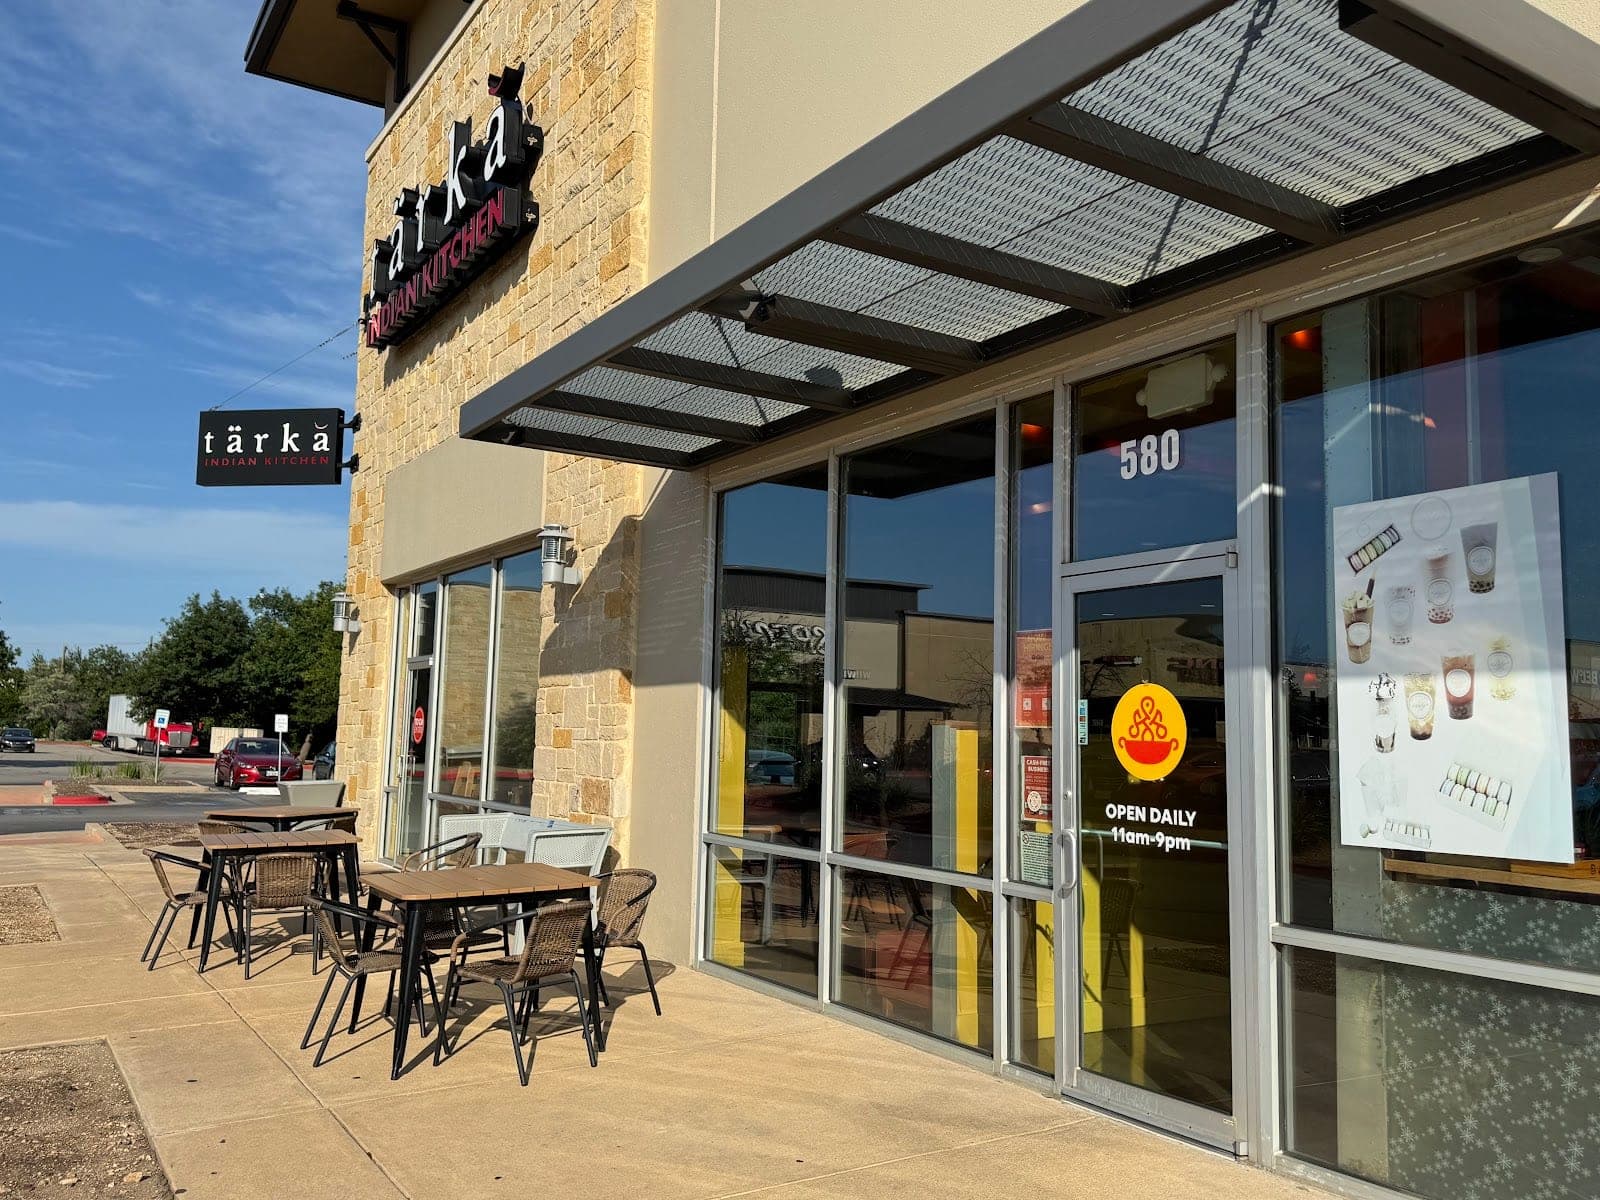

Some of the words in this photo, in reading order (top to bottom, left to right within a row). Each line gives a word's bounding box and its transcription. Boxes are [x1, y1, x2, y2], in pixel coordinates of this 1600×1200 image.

[366, 274, 419, 347] INDIAN
[421, 188, 505, 297] KITCHEN
[204, 457, 257, 467] INDIAN
[264, 456, 330, 466] KITCHEN
[1120, 428, 1180, 480] 580
[1105, 803, 1146, 822] OPEN
[1150, 807, 1197, 827] DAILY
[1111, 826, 1191, 852] 11am-9pm
